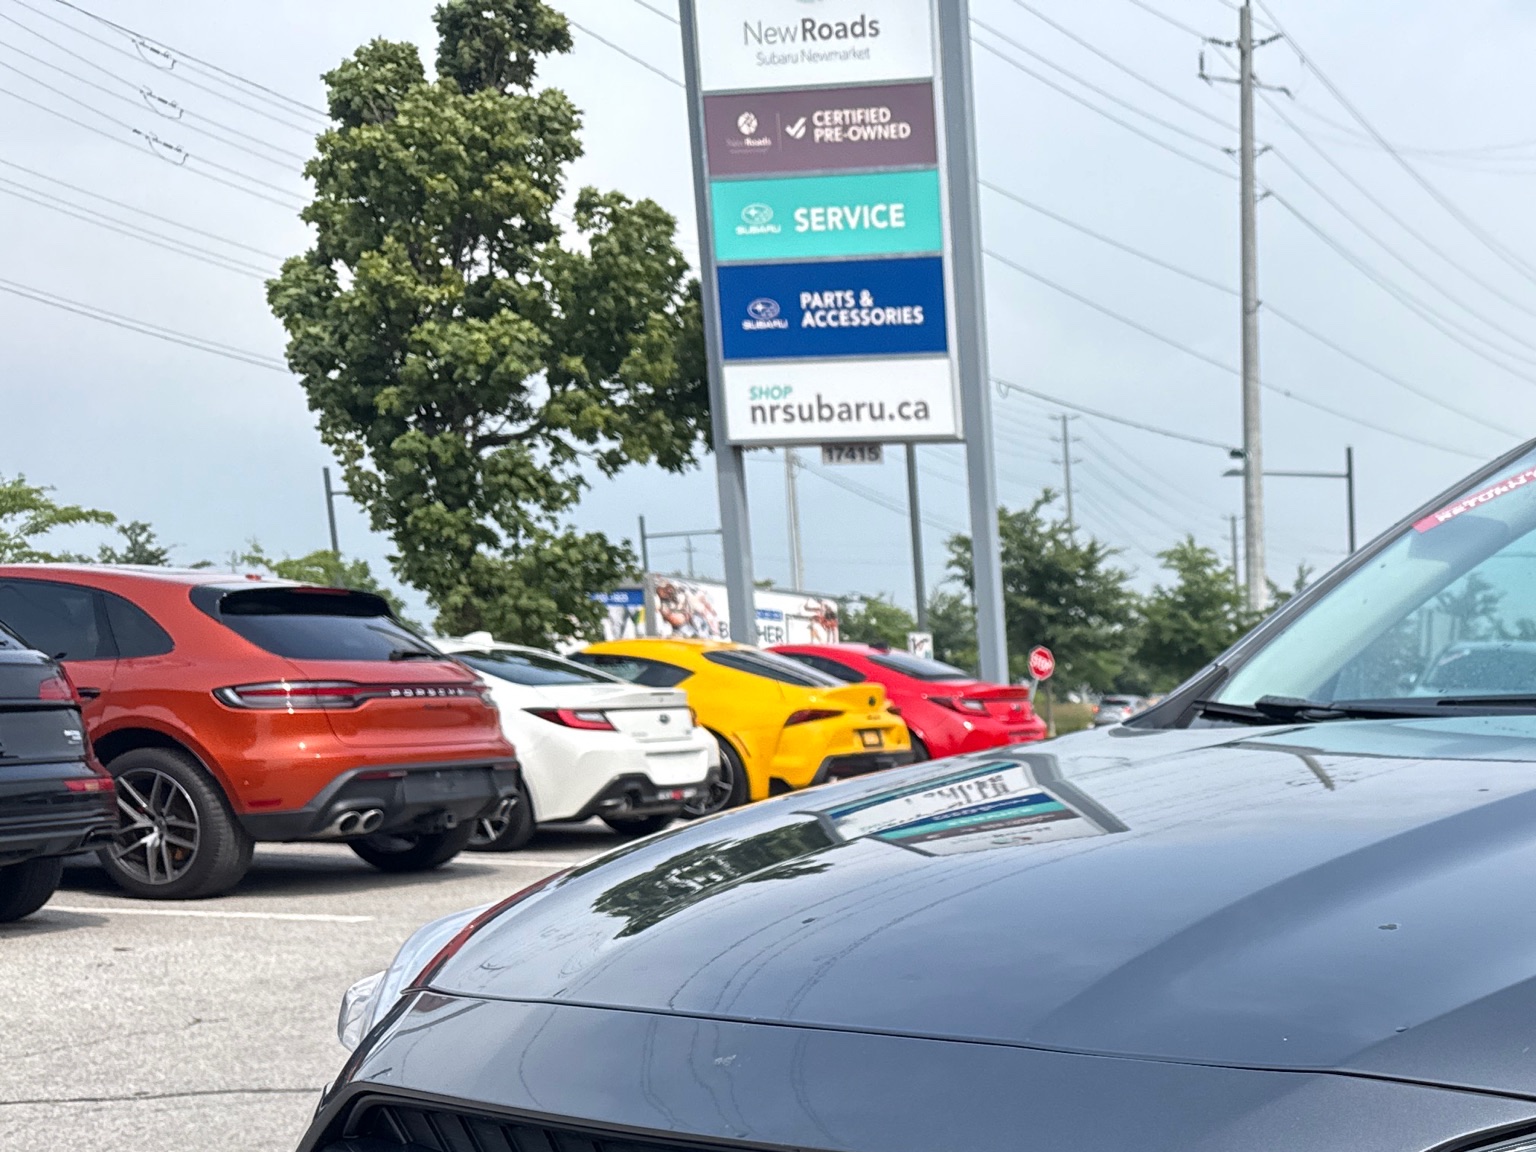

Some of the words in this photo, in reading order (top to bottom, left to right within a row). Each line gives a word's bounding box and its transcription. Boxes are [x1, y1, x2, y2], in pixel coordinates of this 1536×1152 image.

[756, 50, 799, 66] Subaru
[800, 47, 870, 62] Newmarket
[812, 107, 891, 126] CERTIFIED
[813, 122, 911, 143] PRE-OWNED
[794, 203, 906, 232] SERVICE
[735, 224, 782, 235] SUBARU
[800, 291, 854, 309] PARTS
[859, 289, 873, 307] &
[742, 319, 788, 330] SUBARU
[801, 306, 924, 328] ACCESSORIES
[749, 385, 793, 401] SHOP
[750, 394, 930, 424] nrsubaru.ca
[1030, 653, 1053, 671] STOP
[390, 688, 464, 697] PORSCHE
